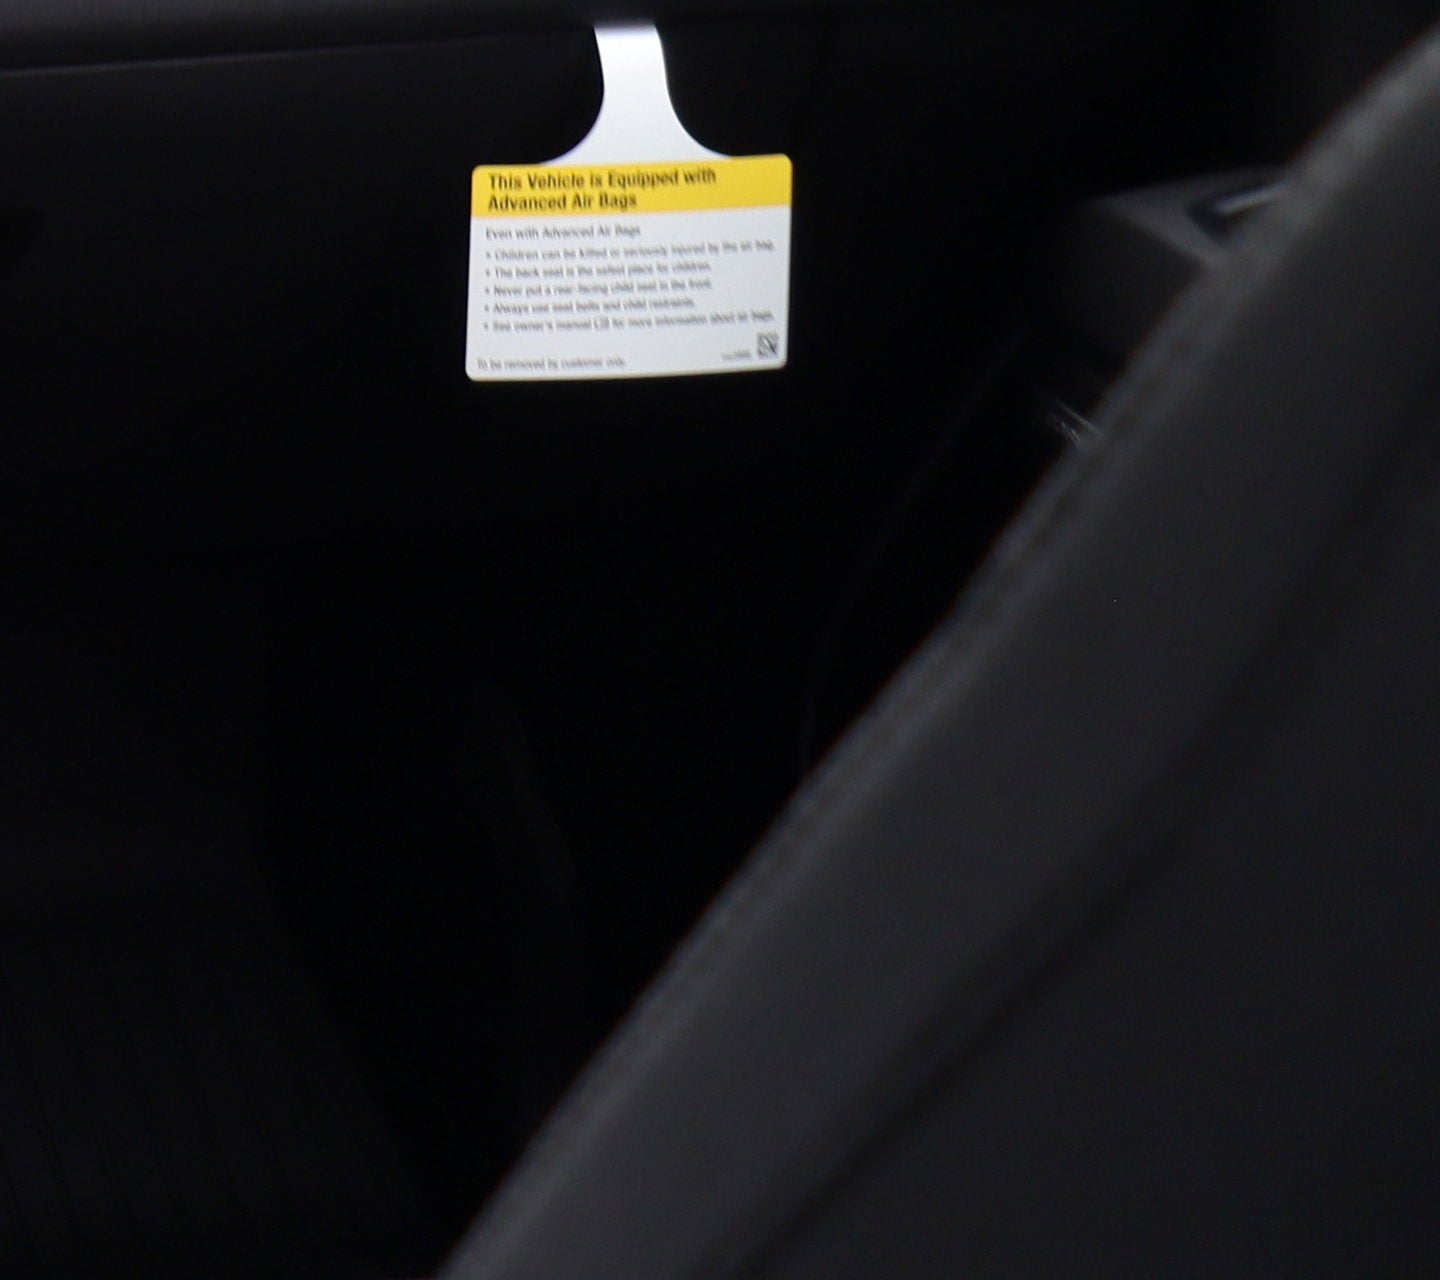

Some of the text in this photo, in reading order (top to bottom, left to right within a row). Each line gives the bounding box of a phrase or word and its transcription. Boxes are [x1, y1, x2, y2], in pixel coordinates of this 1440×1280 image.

[488, 167, 717, 190] This Vehicle is Equipped with
[488, 191, 637, 212] Advanced Air Bags
[485, 223, 641, 240] Even with Advanced Air Bags
